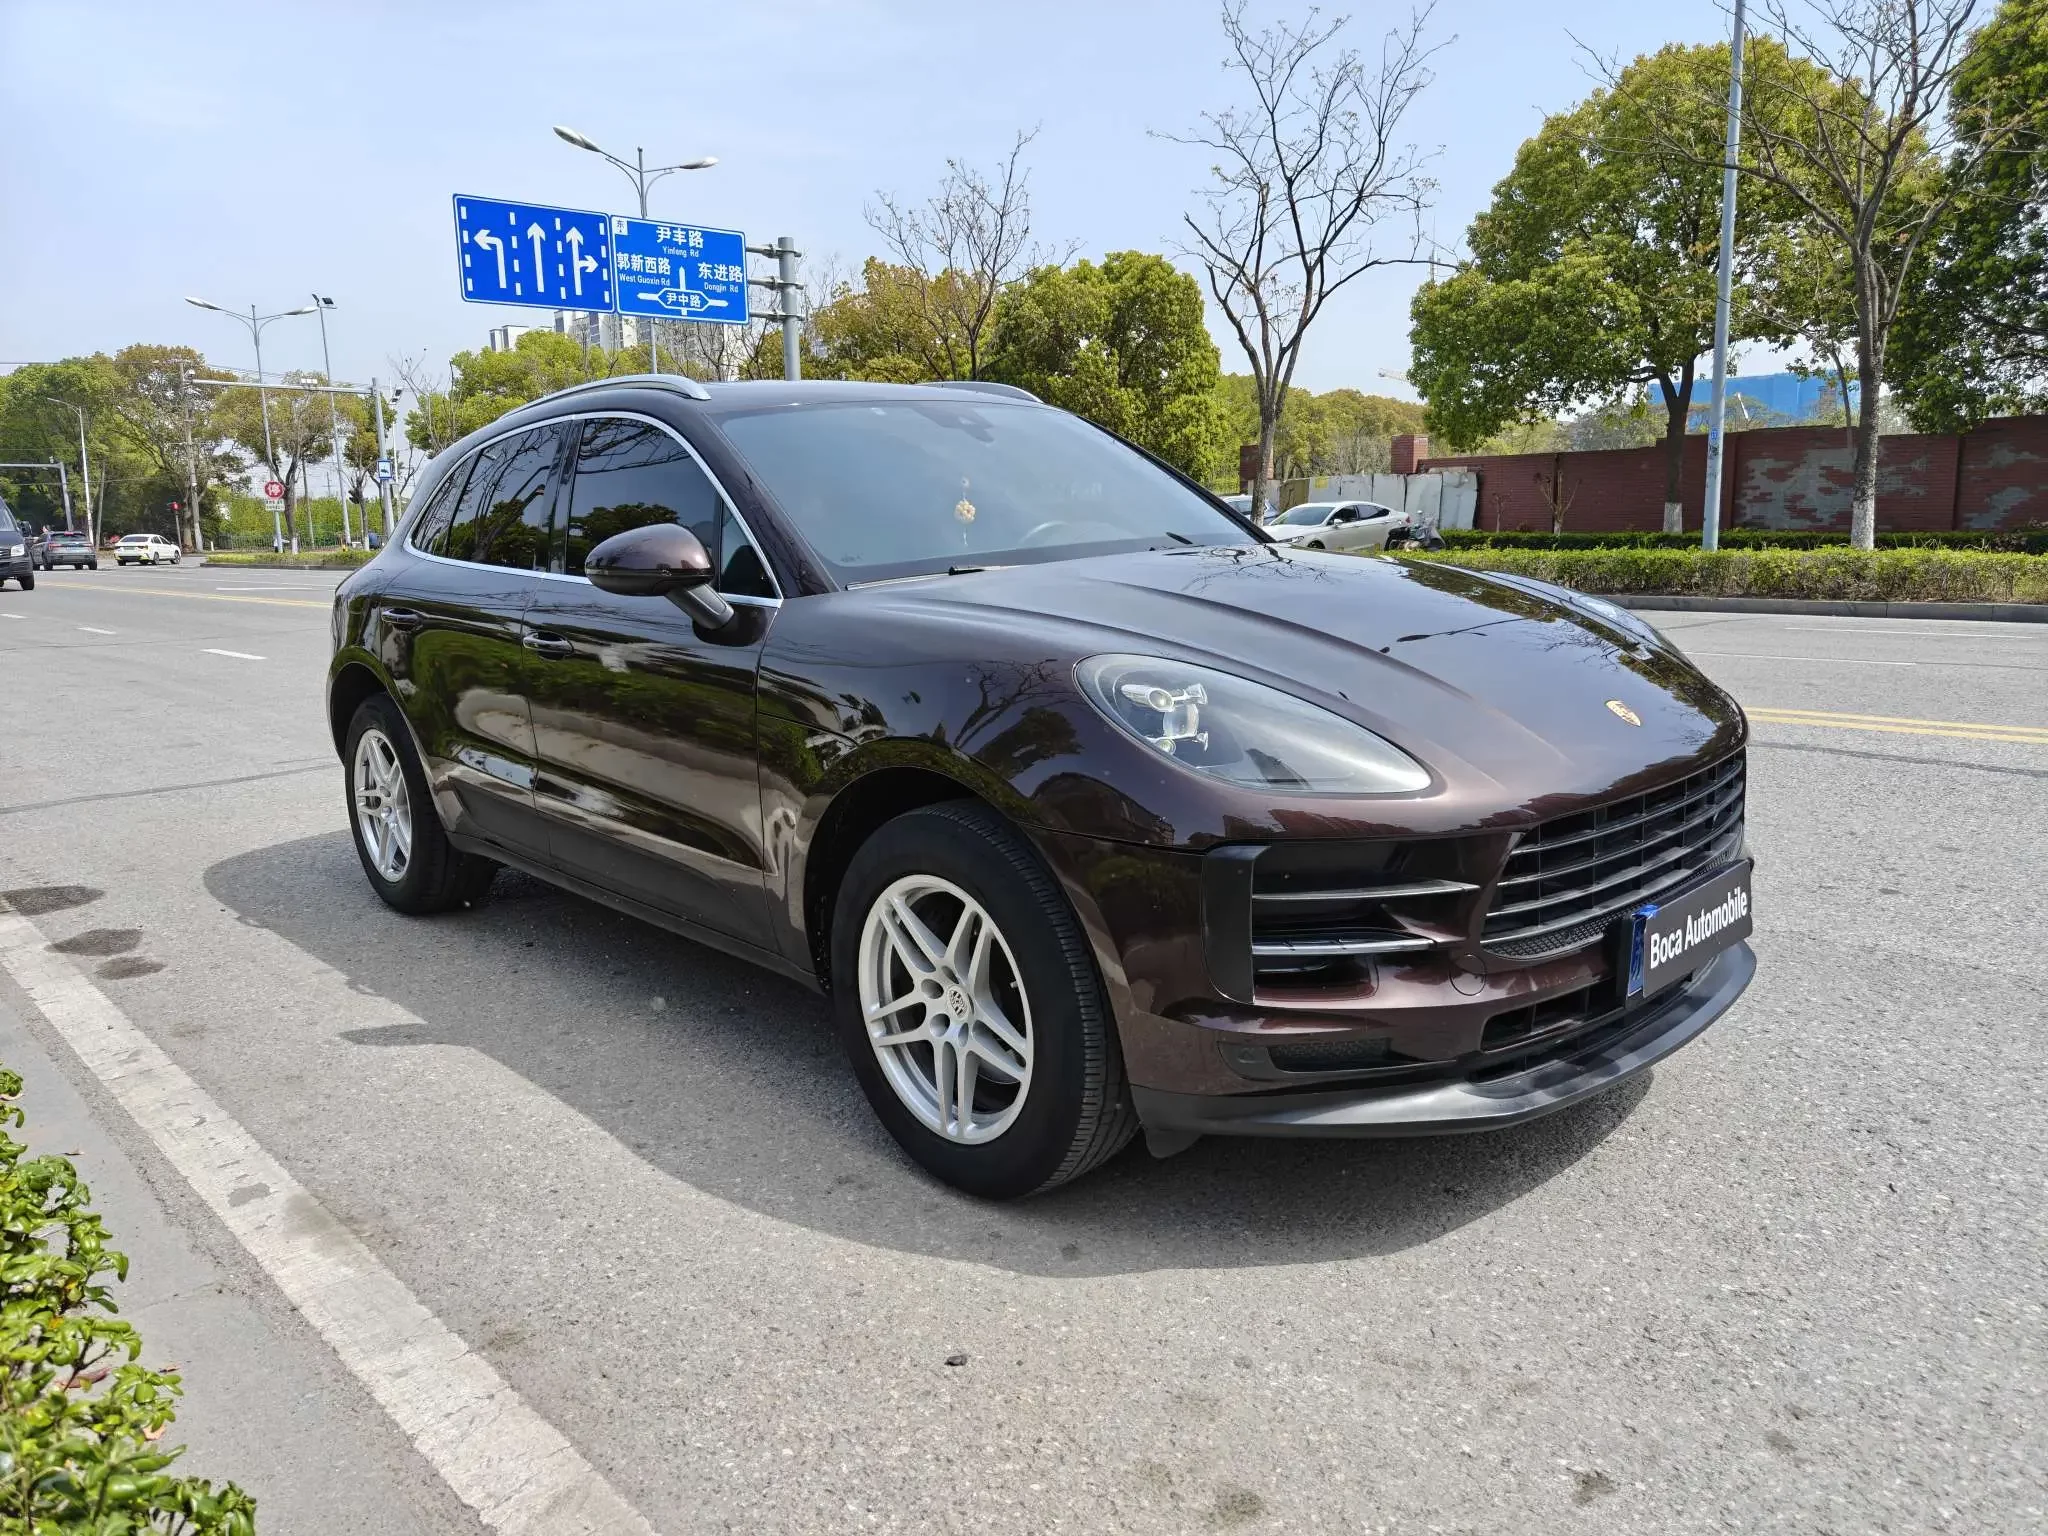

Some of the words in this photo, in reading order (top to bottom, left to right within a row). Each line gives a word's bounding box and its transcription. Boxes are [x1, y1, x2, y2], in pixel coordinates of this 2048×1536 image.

[656, 226, 704, 248] 尹丰路
[689, 248, 699, 257] Rd
[617, 252, 671, 275] 郭新西路
[619, 273, 636, 282] West
[637, 275, 660, 286] Guoxin
[660, 278, 670, 286] Rd
[698, 262, 743, 283] 东进路
[704, 282, 727, 293] Dongjin
[729, 285, 739, 293] Rd
[666, 292, 701, 307] 尹中路
[267, 484, 281, 496] 停
[1650, 928, 1683, 970] Boca
[1684, 886, 1748, 951] Automobile
